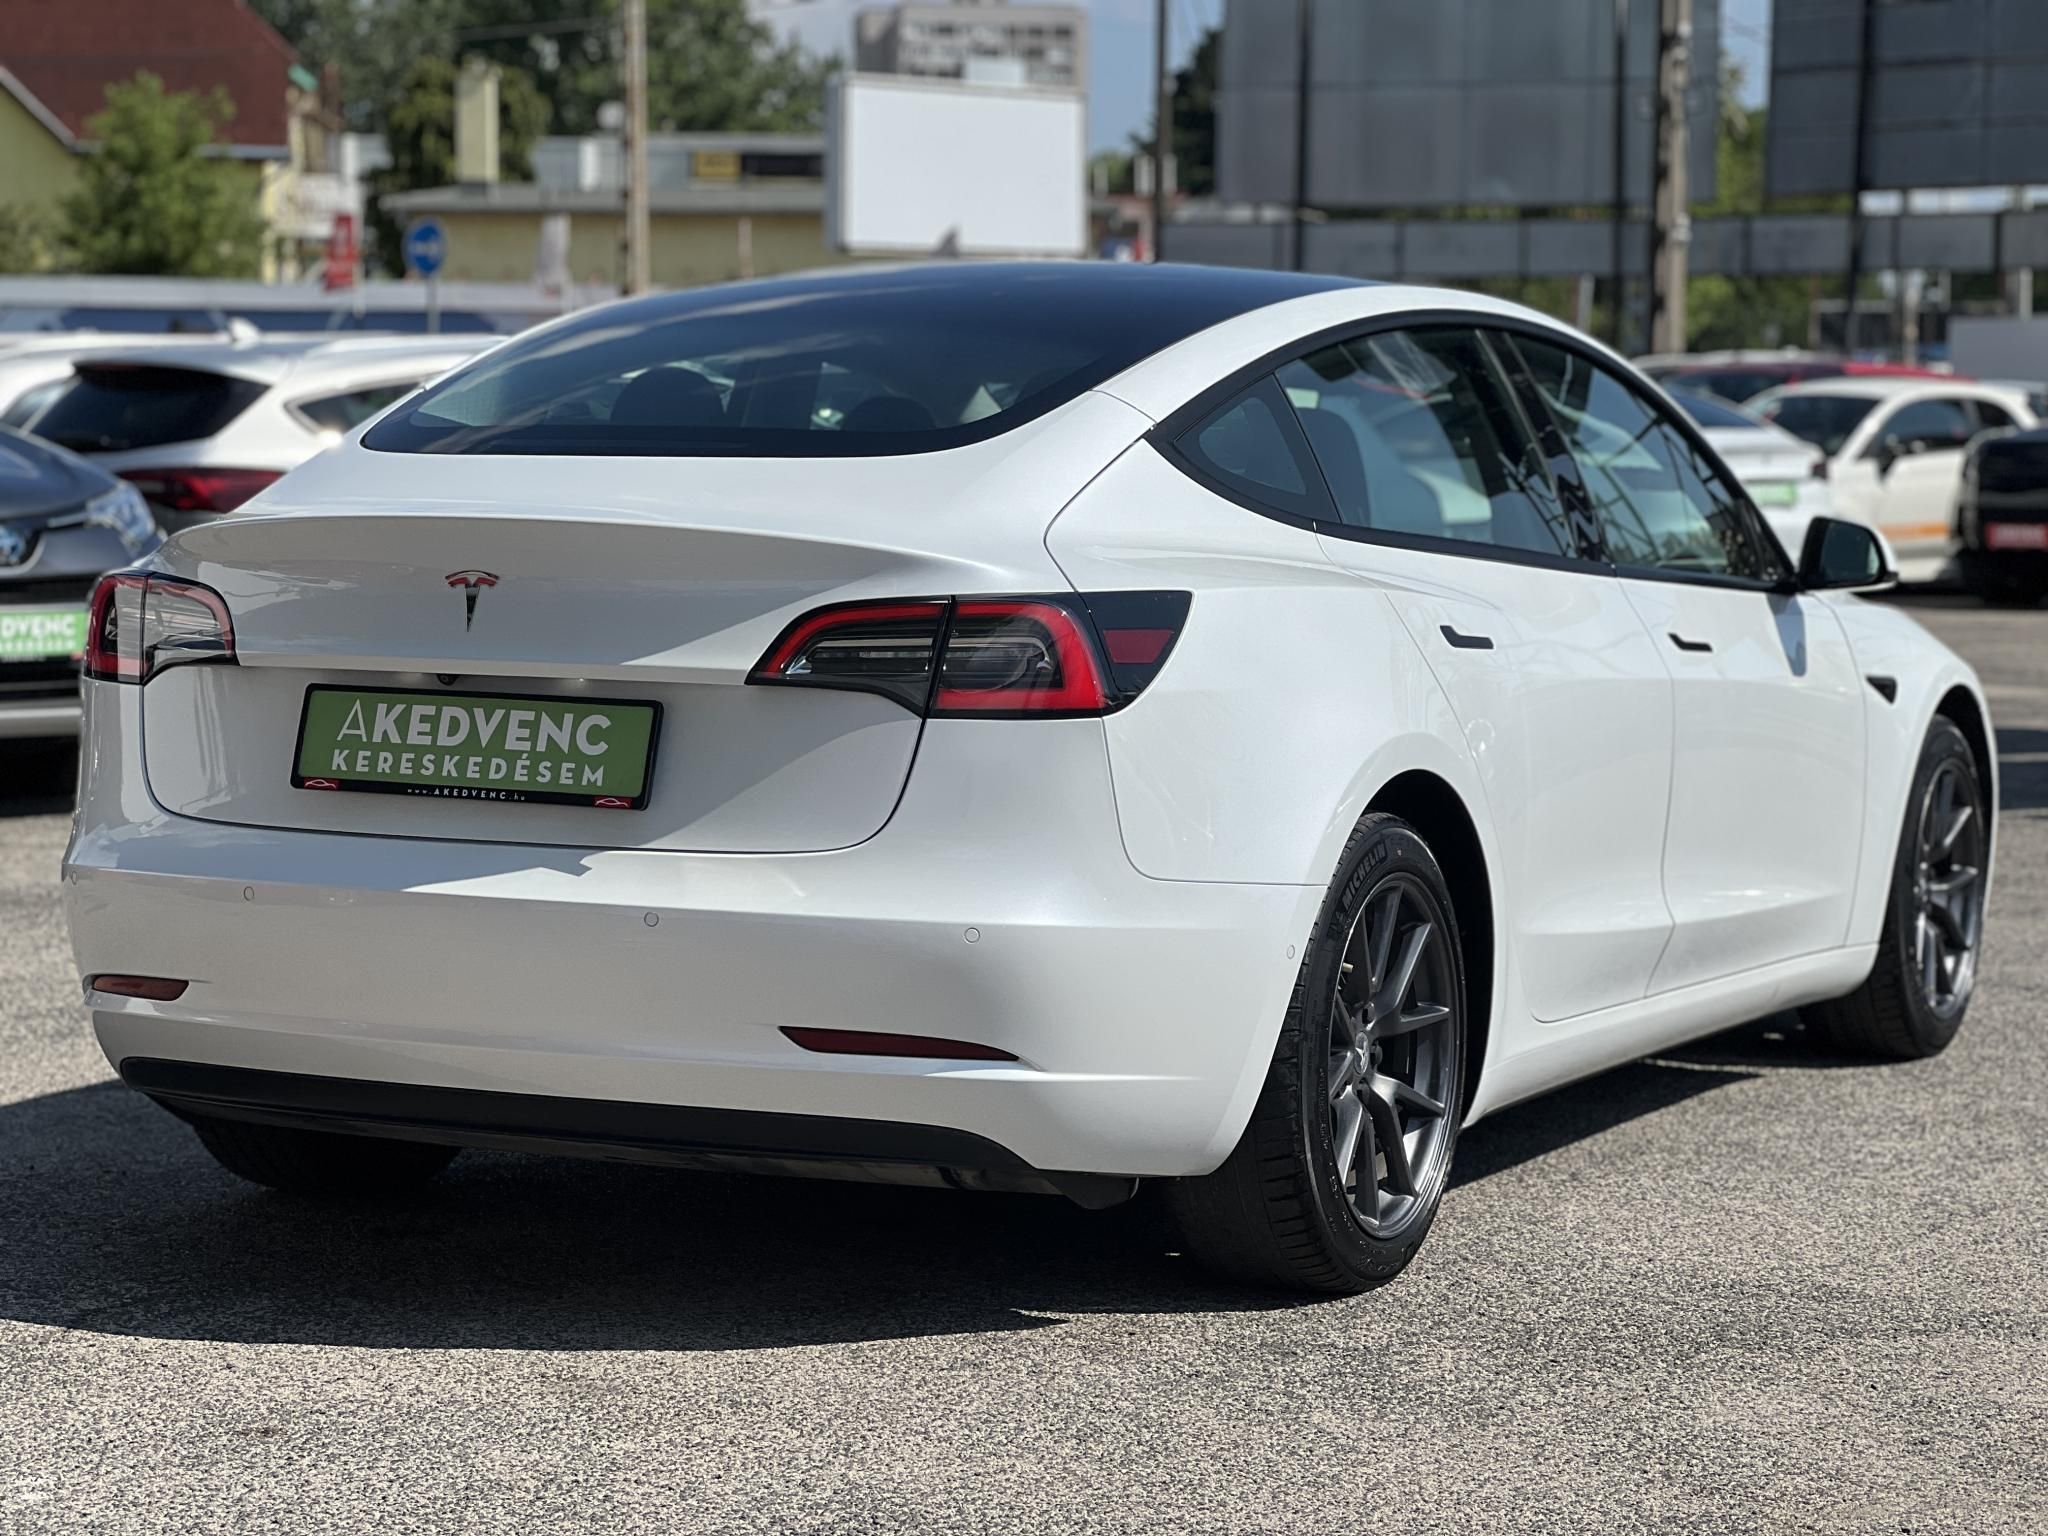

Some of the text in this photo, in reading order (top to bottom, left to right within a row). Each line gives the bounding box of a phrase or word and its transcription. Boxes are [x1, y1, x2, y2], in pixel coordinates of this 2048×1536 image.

[337, 699, 612, 756] AKEDVENC
[331, 749, 604, 786] KERESKEDÉSEM
[1342, 842, 1386, 911] MICHELIN
